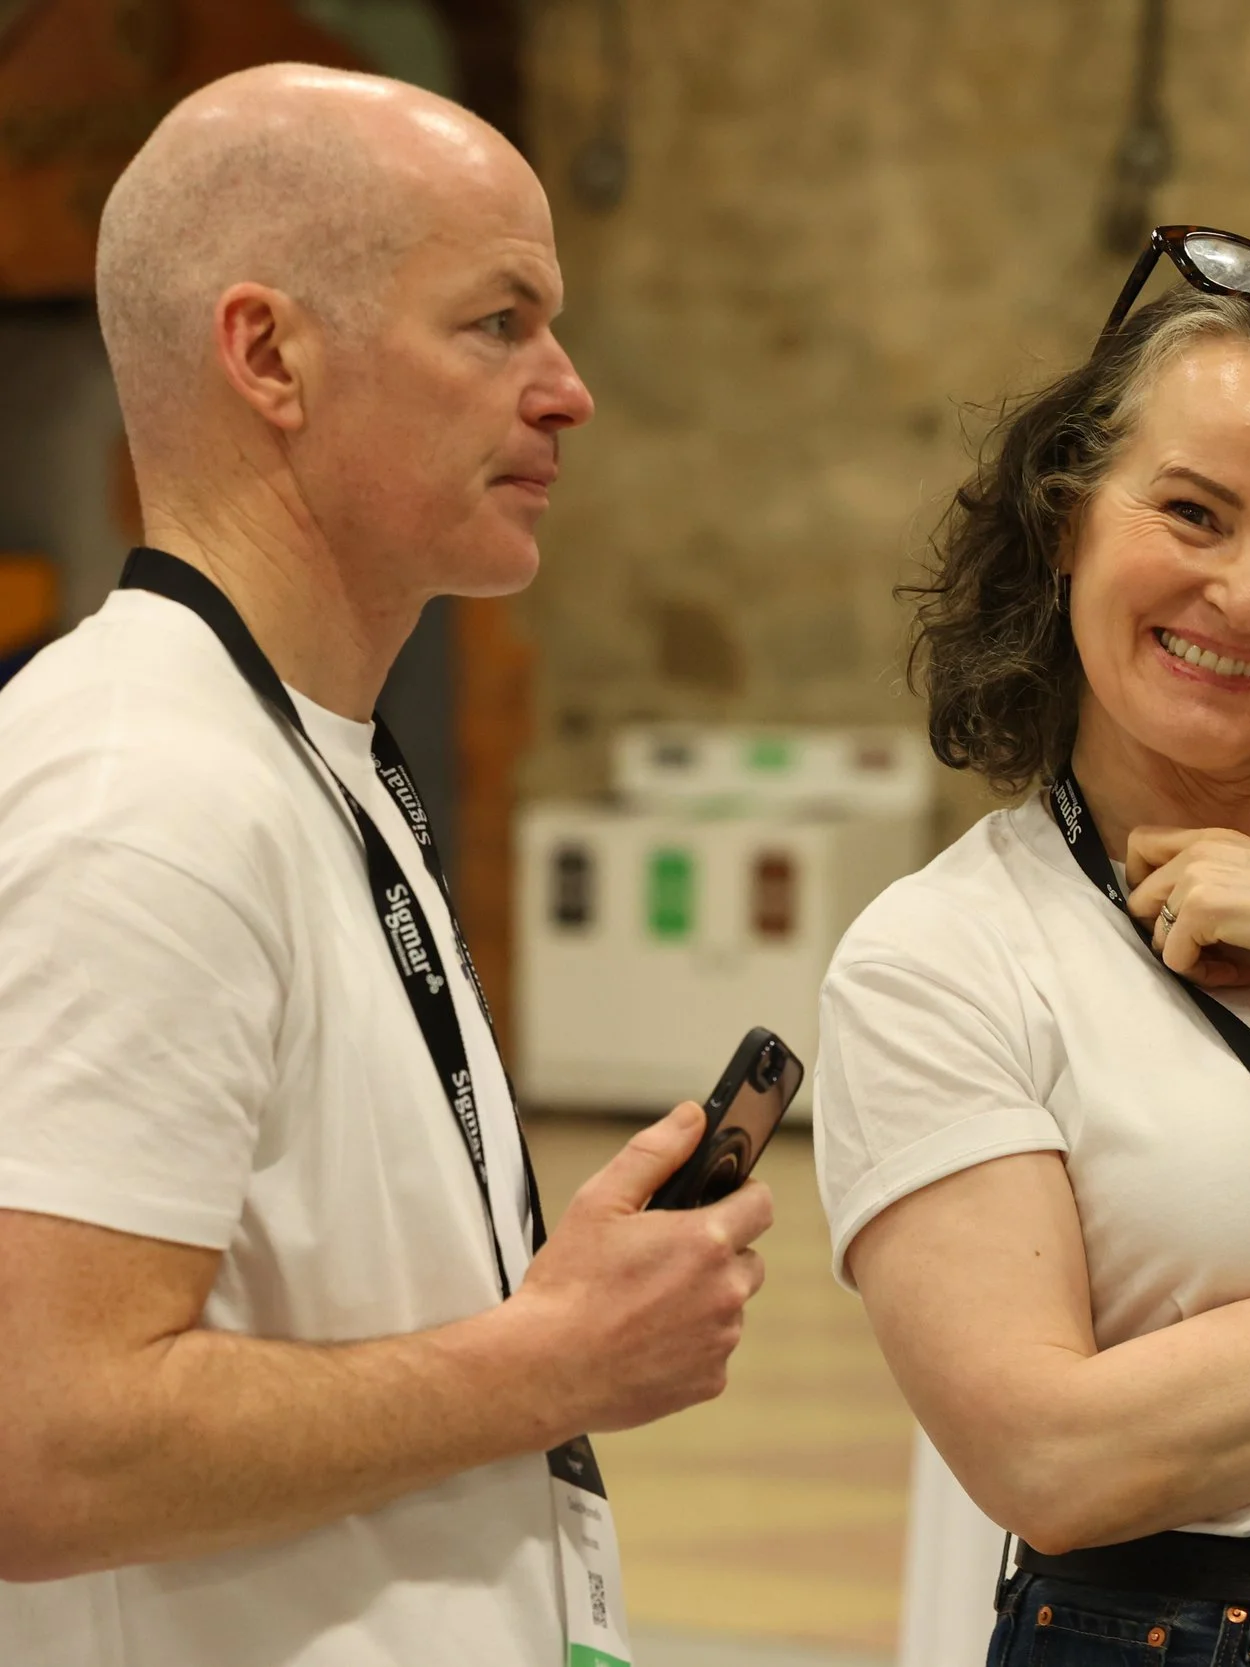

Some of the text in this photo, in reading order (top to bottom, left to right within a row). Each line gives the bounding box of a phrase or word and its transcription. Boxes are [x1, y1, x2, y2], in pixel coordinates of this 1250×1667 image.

[379, 766, 432, 846] Sigmar
[1054, 785, 1082, 844] Sigmar
[384, 883, 434, 974] Sigmar
[452, 1068, 483, 1162] Sigmar
